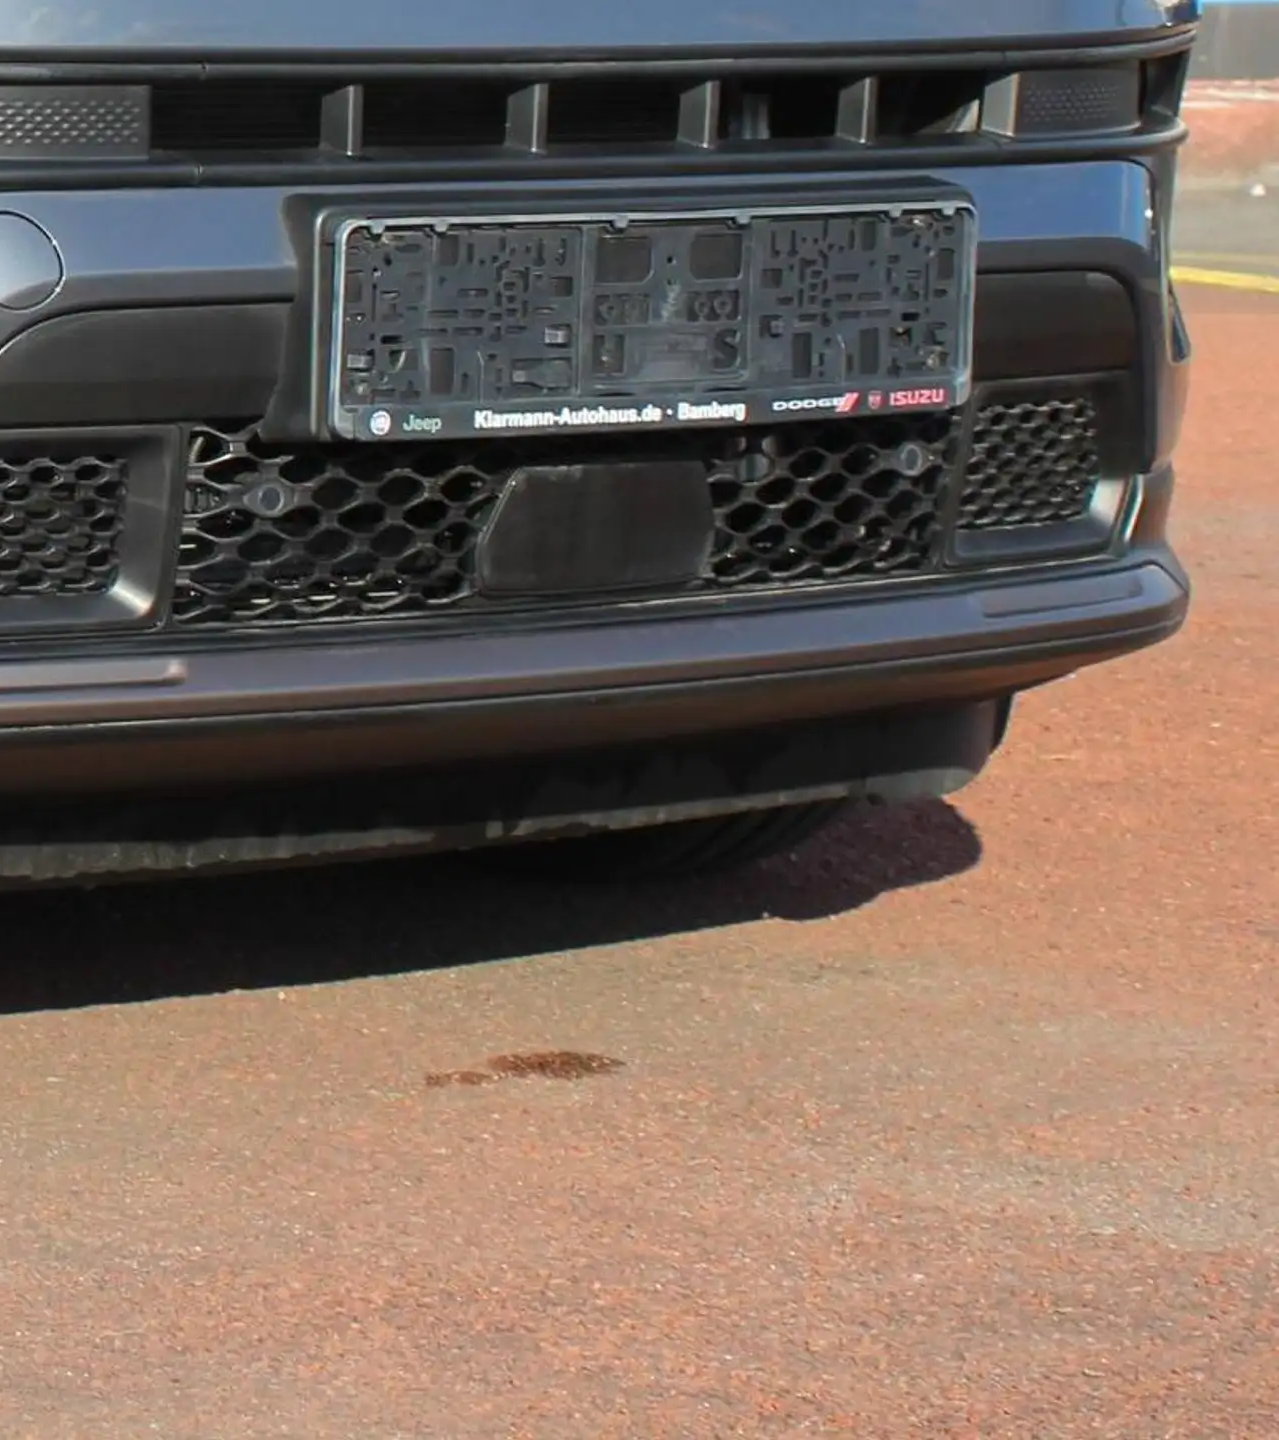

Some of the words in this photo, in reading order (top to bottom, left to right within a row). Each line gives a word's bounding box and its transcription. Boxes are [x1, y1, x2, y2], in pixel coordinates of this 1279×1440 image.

[772, 395, 846, 411] DODGE
[890, 388, 944, 406] ISUZU
[402, 415, 442, 433] Jeep
[474, 404, 662, 429] Klarmann-Autohaus.de
[677, 401, 746, 421] Bamberg
